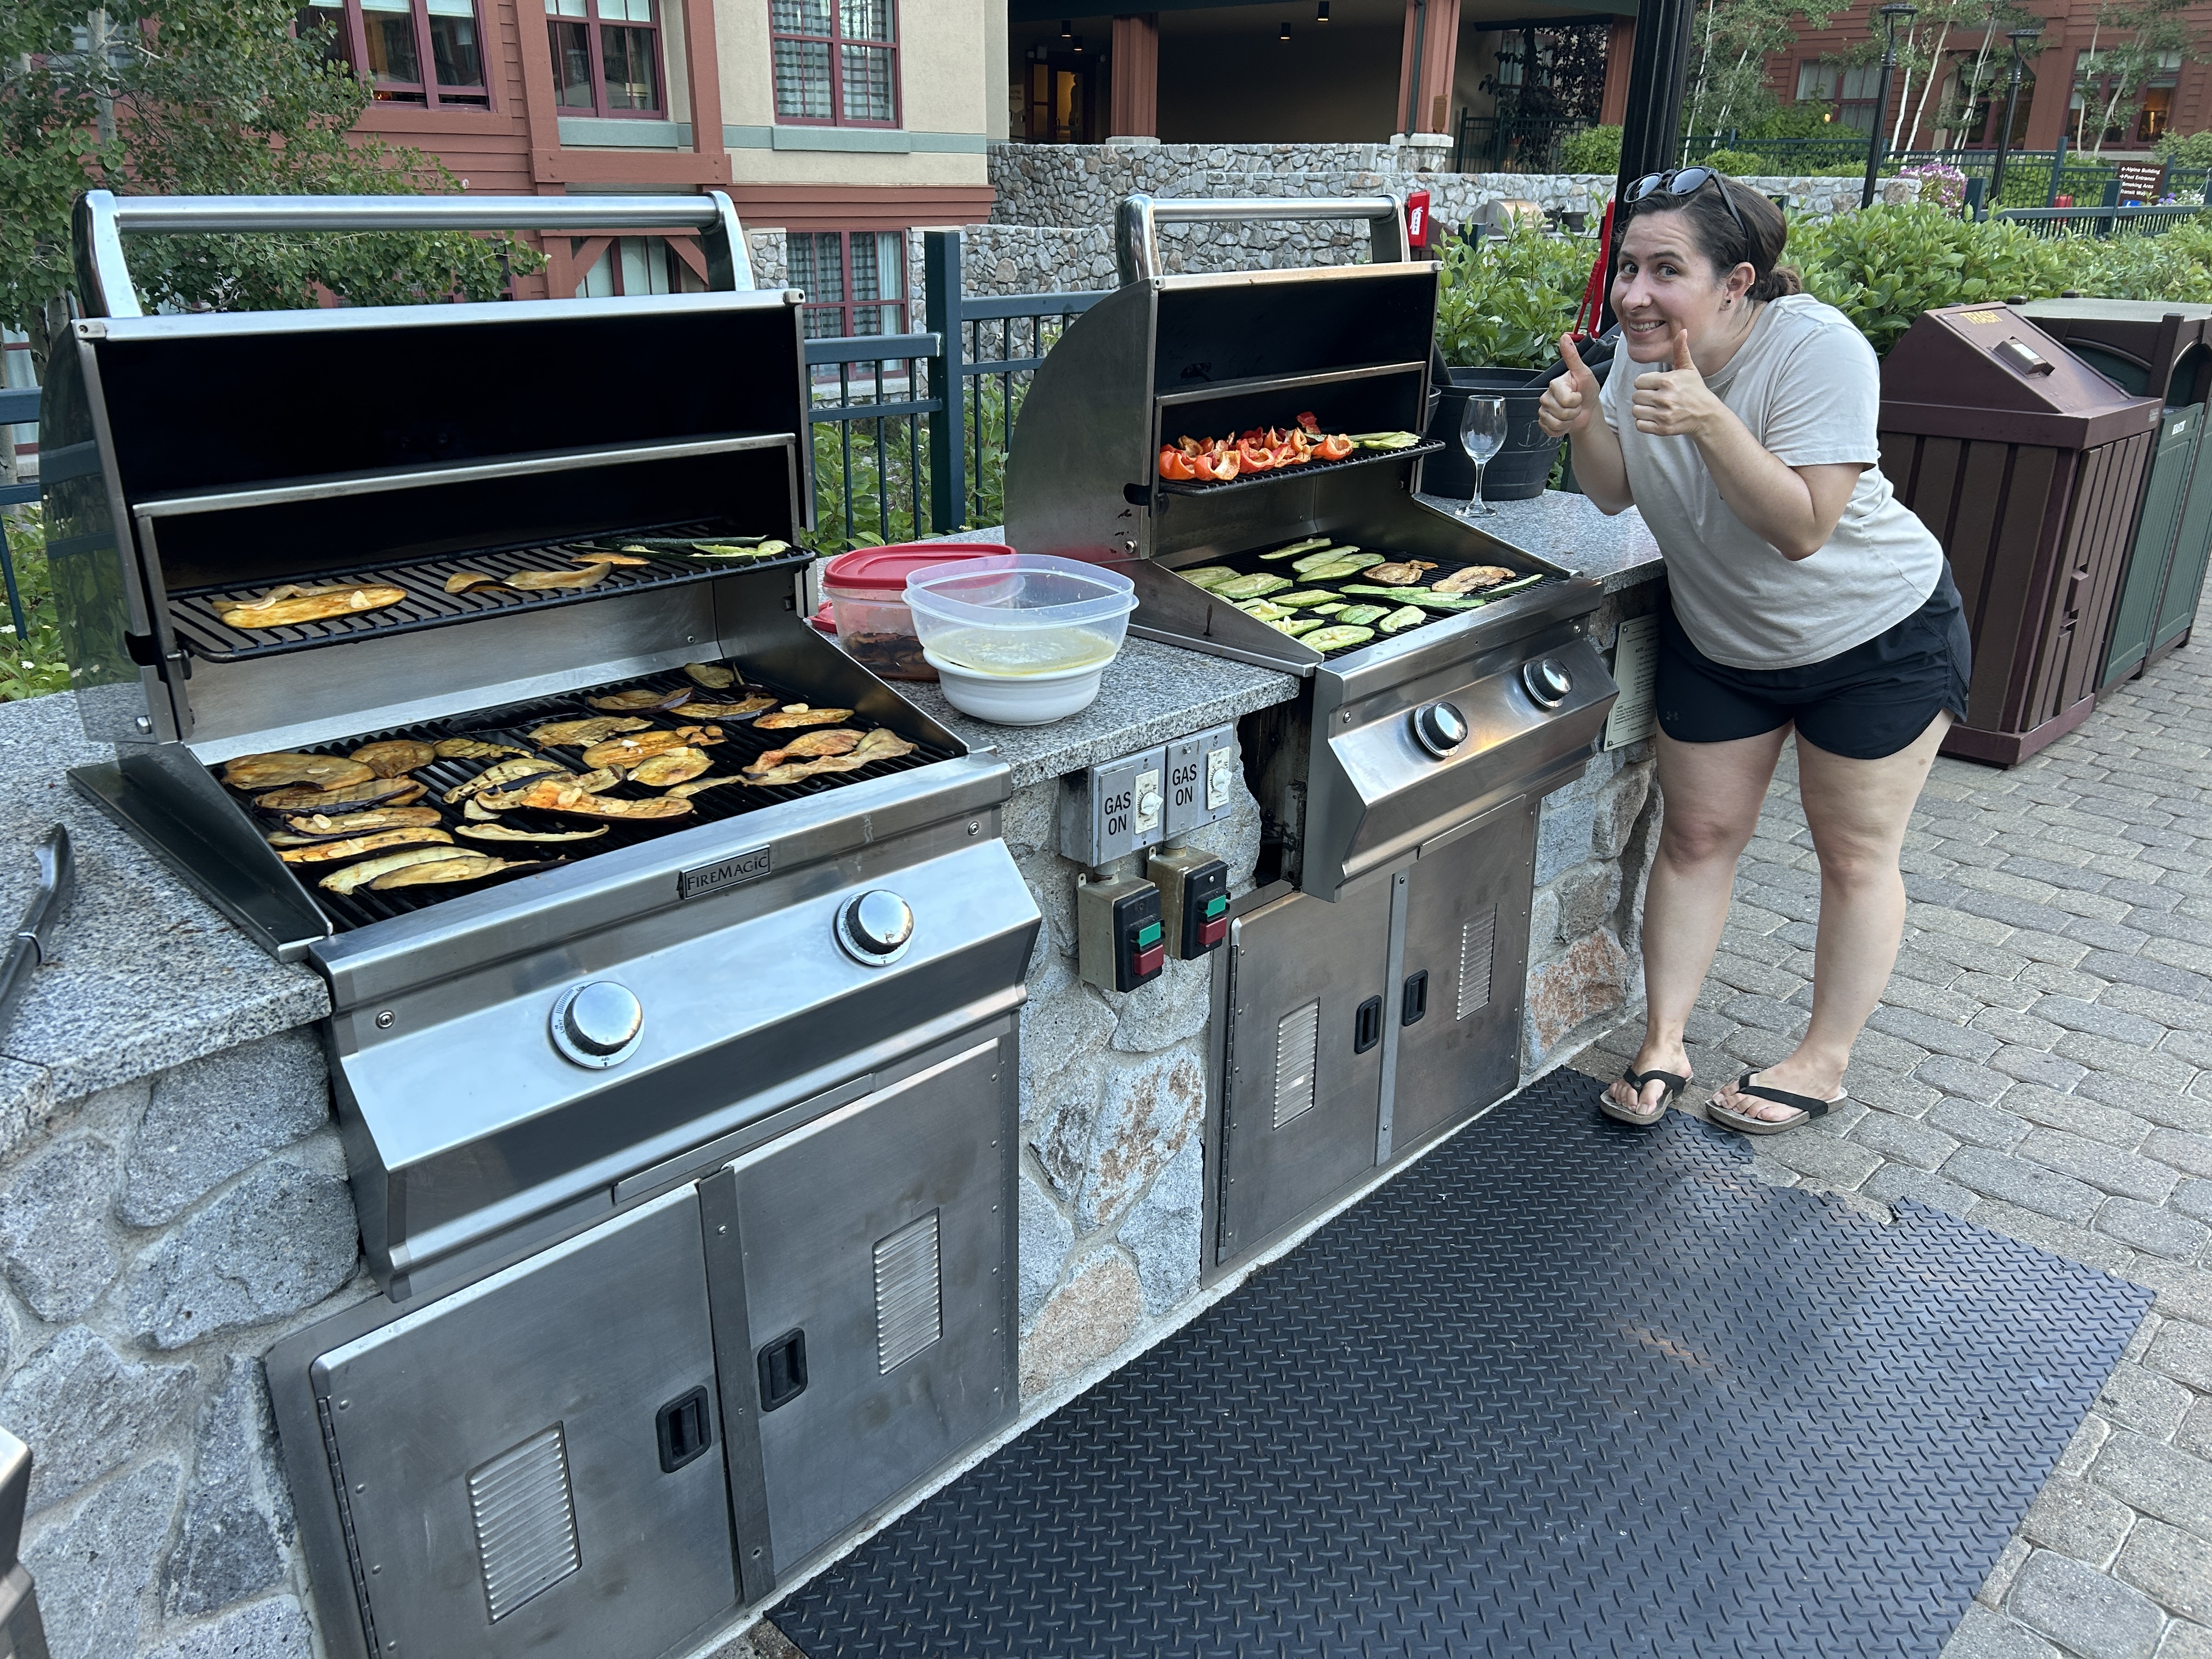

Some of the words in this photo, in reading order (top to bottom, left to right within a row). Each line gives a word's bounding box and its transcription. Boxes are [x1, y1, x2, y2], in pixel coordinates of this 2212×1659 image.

[1960, 311, 2002, 324] TRASH
[1172, 764, 1197, 786] GAS
[1105, 791, 1131, 815] GAS
[1176, 786, 1193, 806] ON
[1109, 814, 1126, 835] ON
